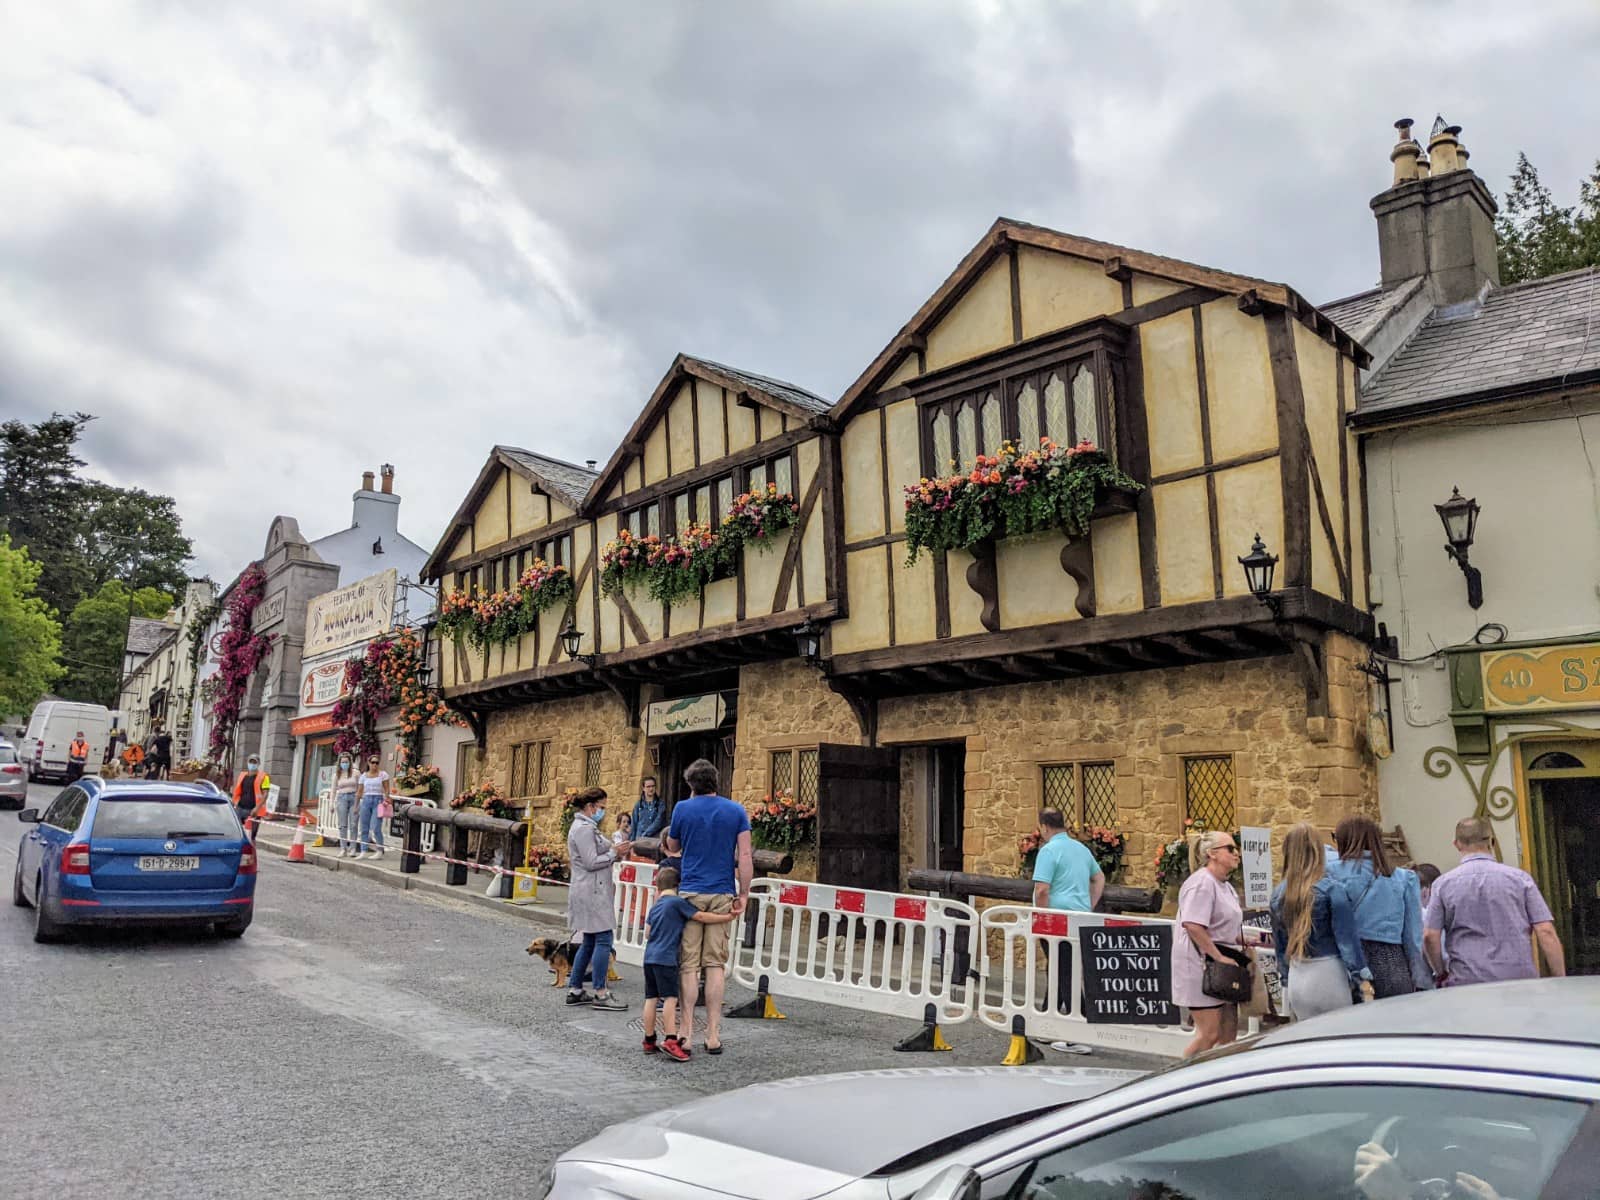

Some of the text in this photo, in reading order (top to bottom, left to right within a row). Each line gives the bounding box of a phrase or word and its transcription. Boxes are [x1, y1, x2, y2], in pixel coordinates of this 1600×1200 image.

[358, 585, 366, 598] OF
[1501, 656, 1600, 693] 40 S
[142, 856, 196, 871] 151-D-29947
[1095, 956, 1161, 971] DO NOT
[1101, 978, 1160, 992] TOUCH
[1094, 999, 1129, 1014] THE
